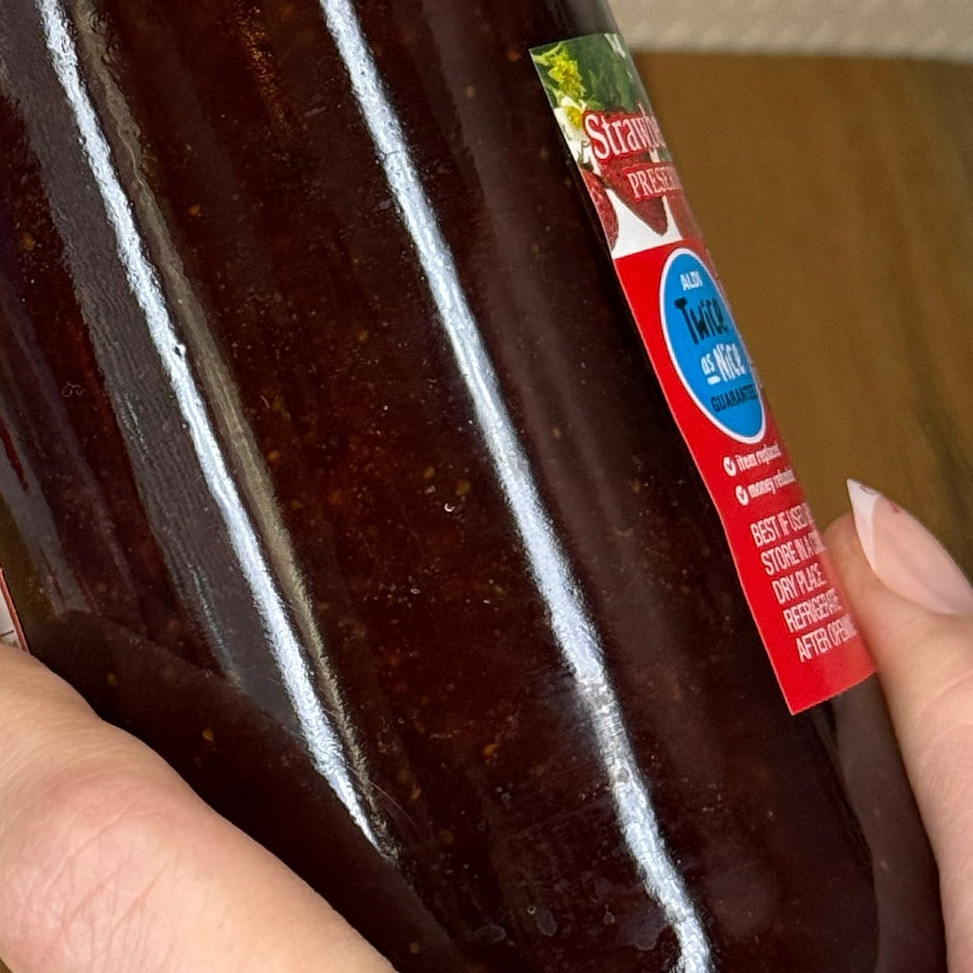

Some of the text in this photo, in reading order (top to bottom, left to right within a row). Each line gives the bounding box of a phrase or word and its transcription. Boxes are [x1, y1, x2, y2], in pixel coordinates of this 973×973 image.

[679, 270, 704, 292] ALDI
[673, 296, 728, 346] Twice
[700, 342, 747, 383] as Nice
[735, 451, 758, 472] item
[747, 477, 777, 499] money
[750, 515, 780, 548] BEST
[777, 509, 790, 536] IF
[760, 542, 801, 576] STORE
[771, 576, 799, 605] DRY
[795, 627, 830, 663] AFTER
